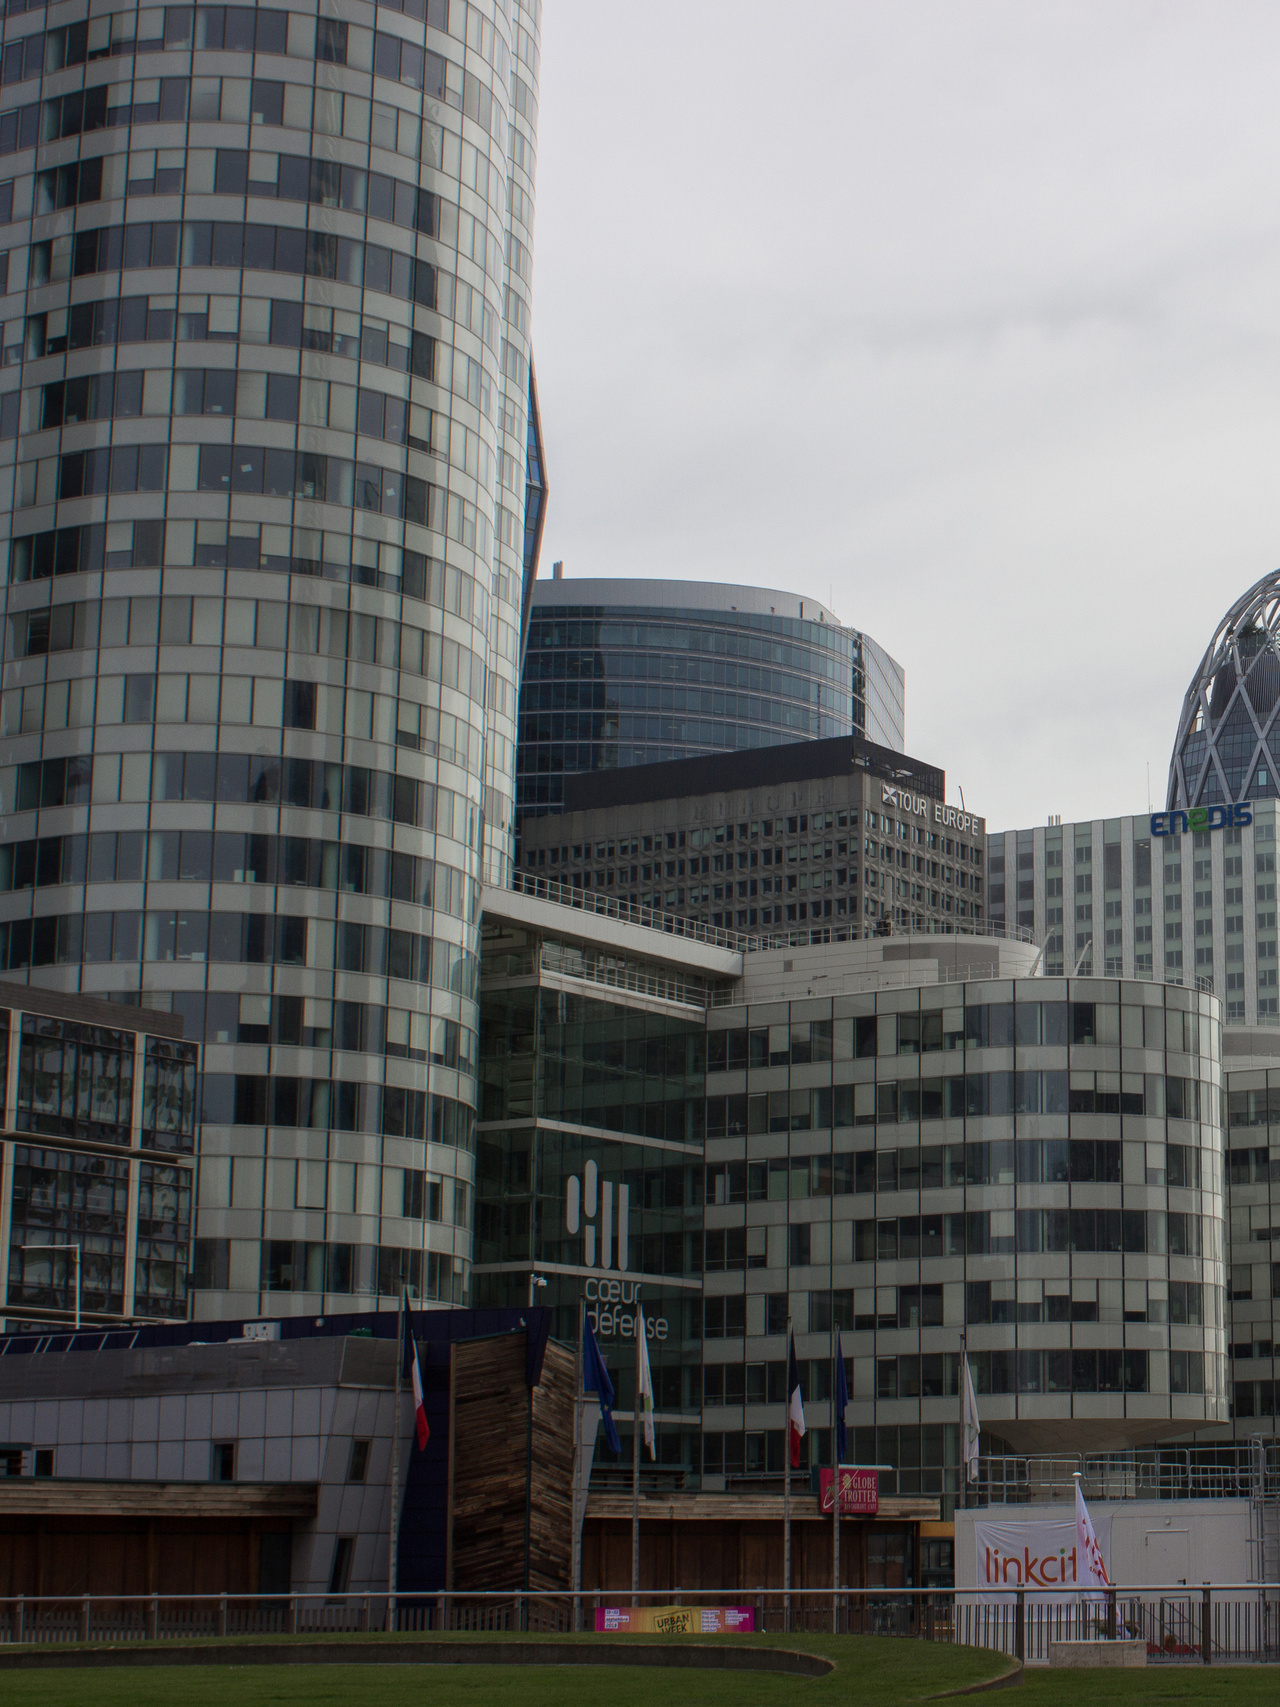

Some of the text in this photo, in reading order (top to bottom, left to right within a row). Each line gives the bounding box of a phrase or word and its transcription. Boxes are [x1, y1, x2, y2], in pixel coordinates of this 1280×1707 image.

[897, 790, 978, 836] TOUR EUROPE
[585, 1278, 642, 1304] cœur
[852, 1477, 876, 1489] GLOBE
[844, 1490, 877, 1502] TROTTER
[986, 1546, 1077, 1586] linkcit
[657, 1613, 690, 1628] URBAN
